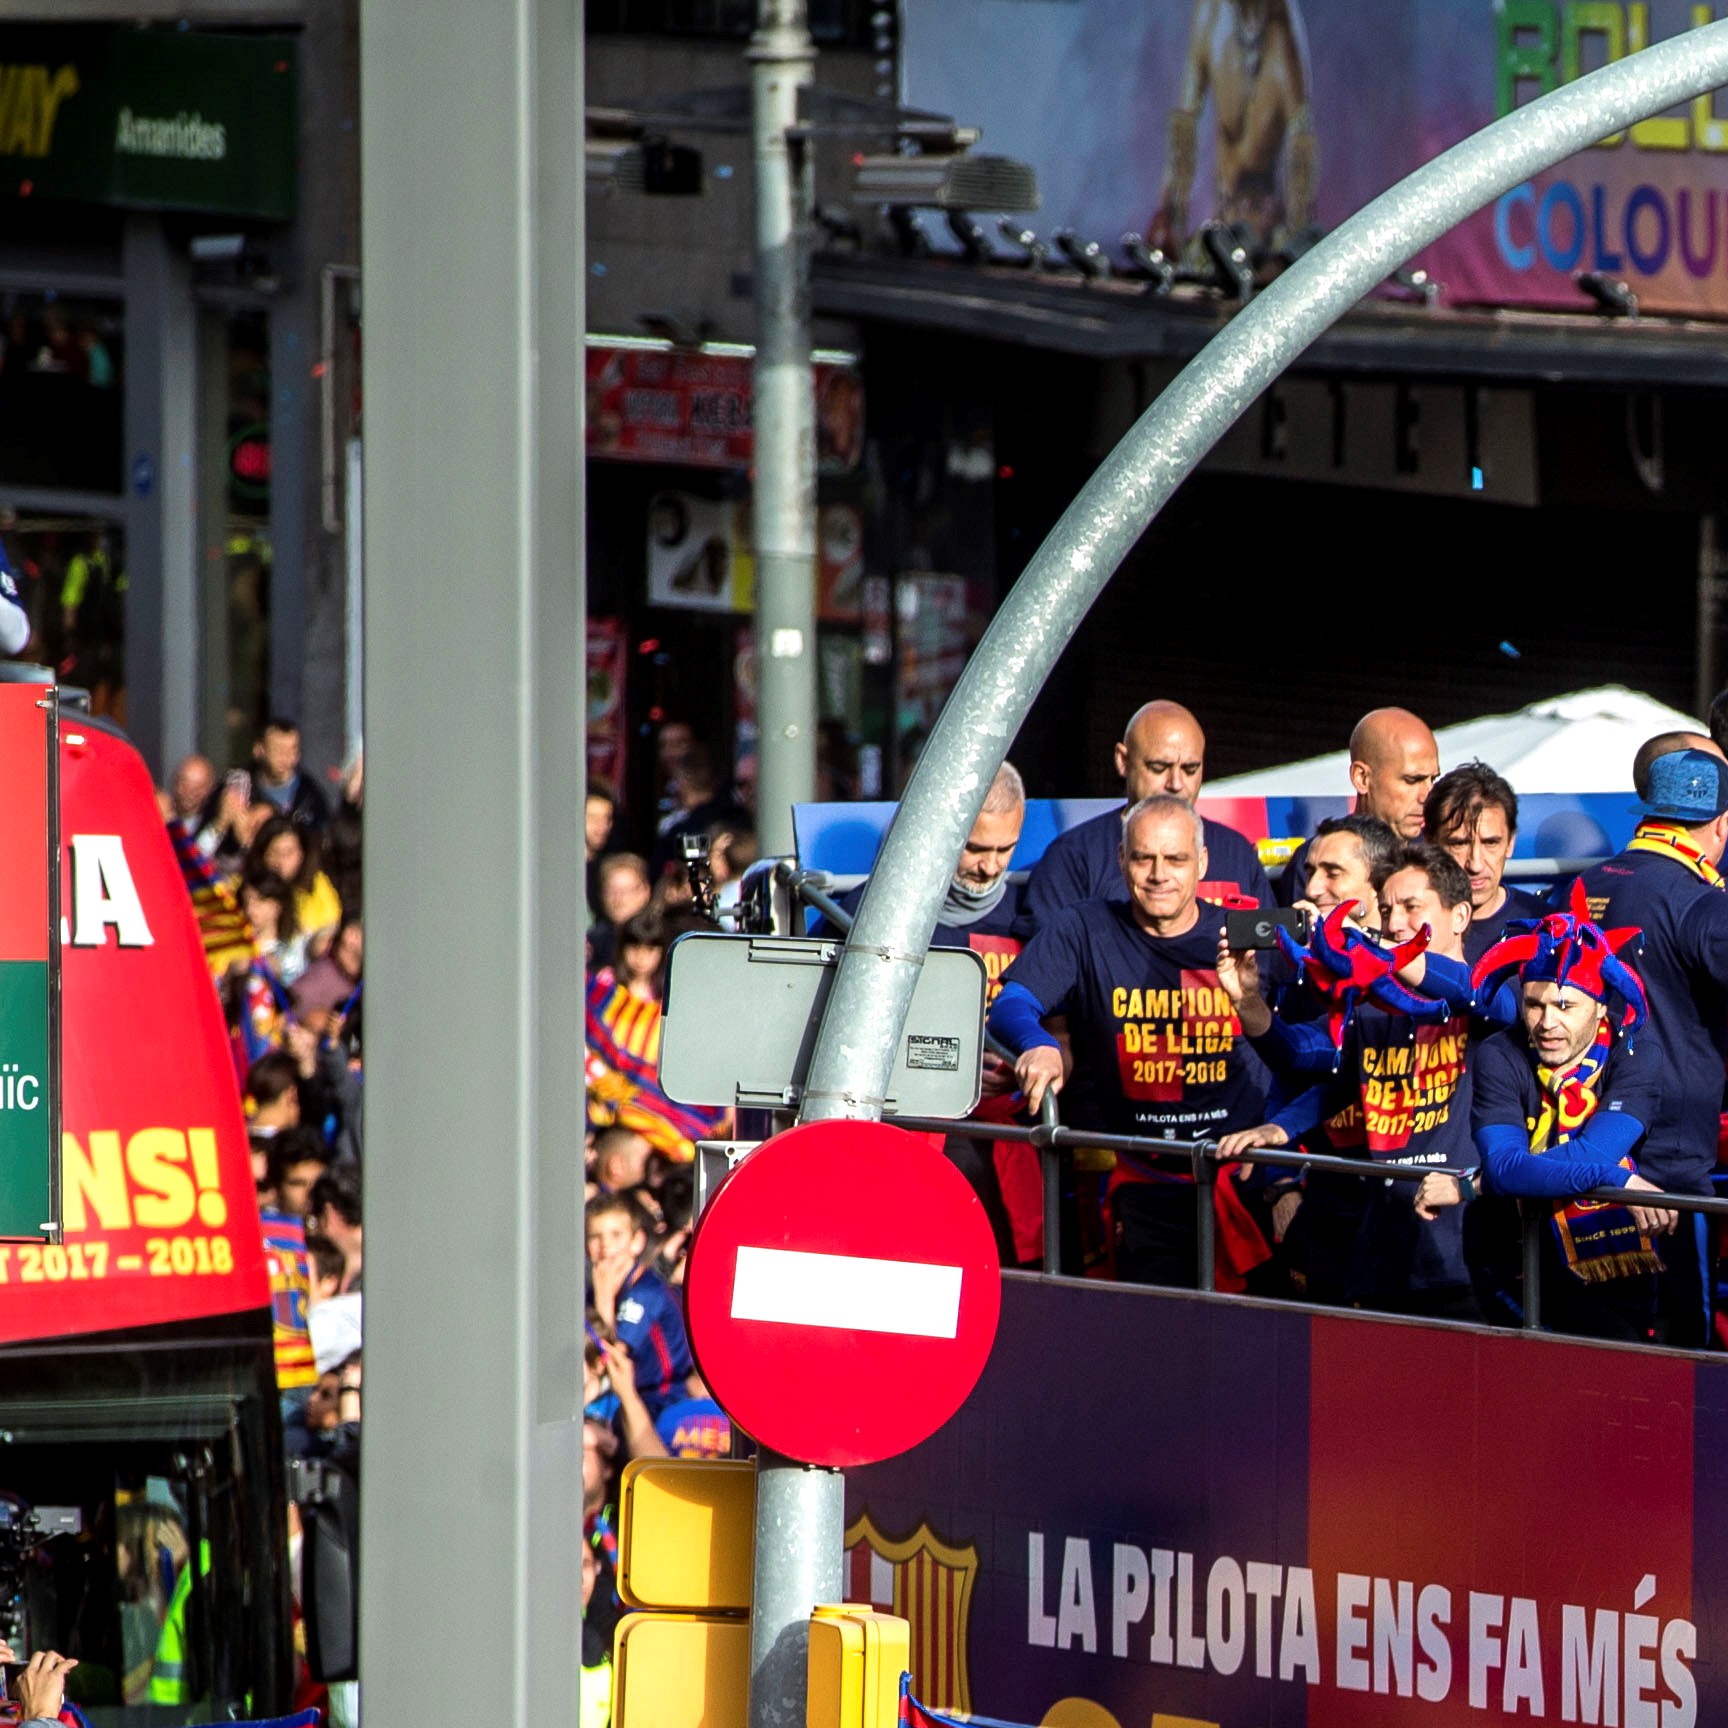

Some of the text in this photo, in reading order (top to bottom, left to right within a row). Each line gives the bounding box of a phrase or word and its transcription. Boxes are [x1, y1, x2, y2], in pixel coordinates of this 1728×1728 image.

[62, 835, 154, 948] A
[1112, 985, 1239, 1019] CAMPION
[1123, 1021, 1234, 1054] DE LLIGA
[1366, 1077, 1397, 1112] DE
[26, 1247, 113, 1282] 2017
[149, 1237, 232, 1276] 2018
[1026, 1531, 1097, 1656] LA
[1112, 1542, 1321, 1686] PILOTA
[1336, 1572, 1453, 1705] ENS
[1468, 1591, 1546, 1720] FA
